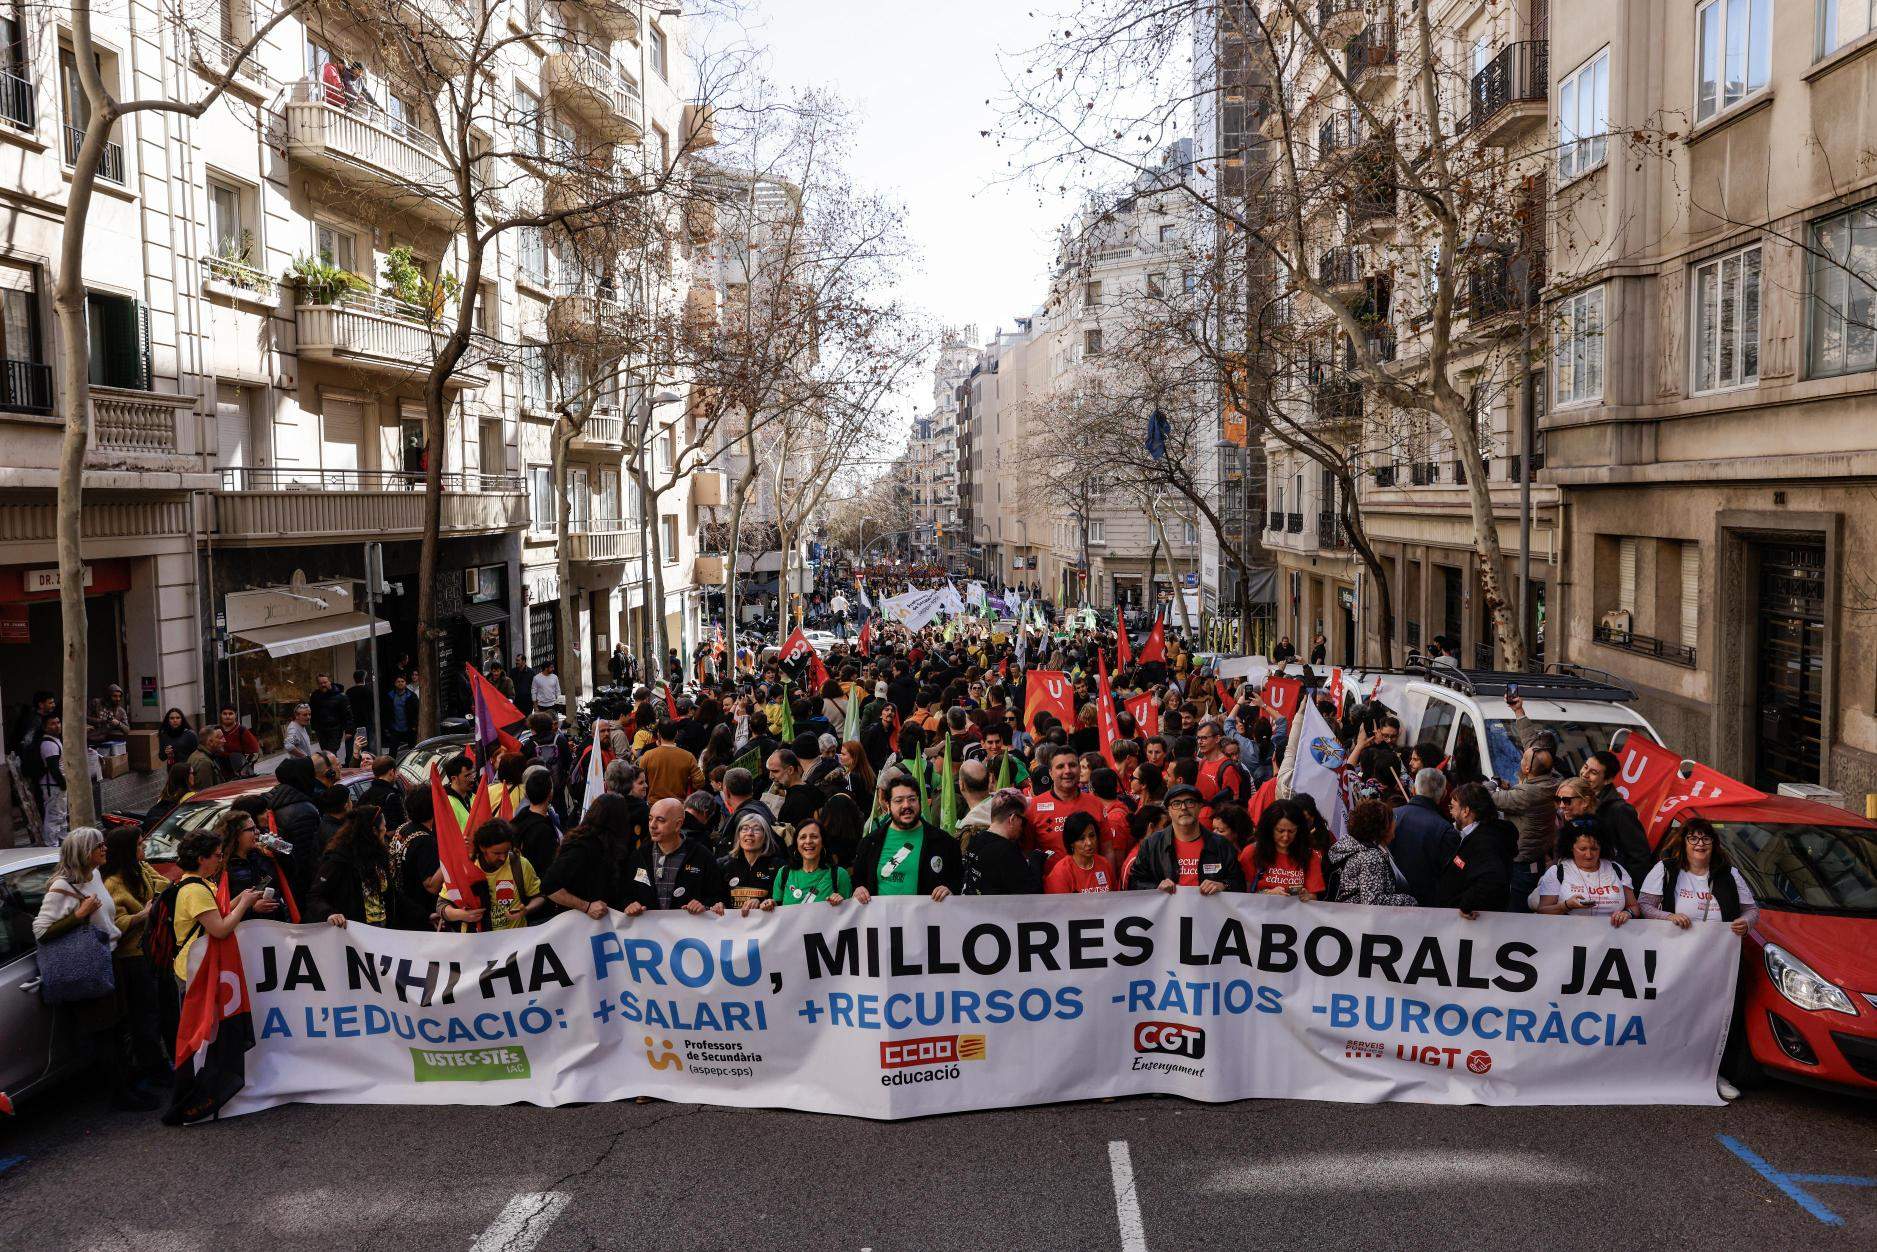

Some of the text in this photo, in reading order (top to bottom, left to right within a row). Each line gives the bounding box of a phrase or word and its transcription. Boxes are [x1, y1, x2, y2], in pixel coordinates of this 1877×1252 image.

[40, 574, 54, 585] DR.
[256, 945, 326, 993] JA
[479, 942, 575, 1000] HA
[590, 931, 783, 995] PROU,
[804, 916, 1154, 980] MILLORES
[1179, 915, 1540, 993] LABORALS
[1560, 945, 1657, 1000] JA!
[262, 1007, 294, 1040] A
[592, 982, 768, 1032] +SALARI
[798, 985, 1085, 1031] +RECURSOS
[1111, 970, 1284, 1017] -RÀTIOS
[1311, 991, 1648, 1047] -BUROCRÀCIA
[684, 1039, 743, 1051] Professors
[885, 1040, 952, 1064] CCOO
[1139, 1025, 1201, 1055] CGT
[1346, 1039, 1385, 1050] SERVEIS
[686, 1050, 763, 1063] de Secundària
[1131, 1056, 1205, 1078] Ensenyament
[1396, 1044, 1461, 1069] UGT
[881, 1063, 961, 1087] educació
